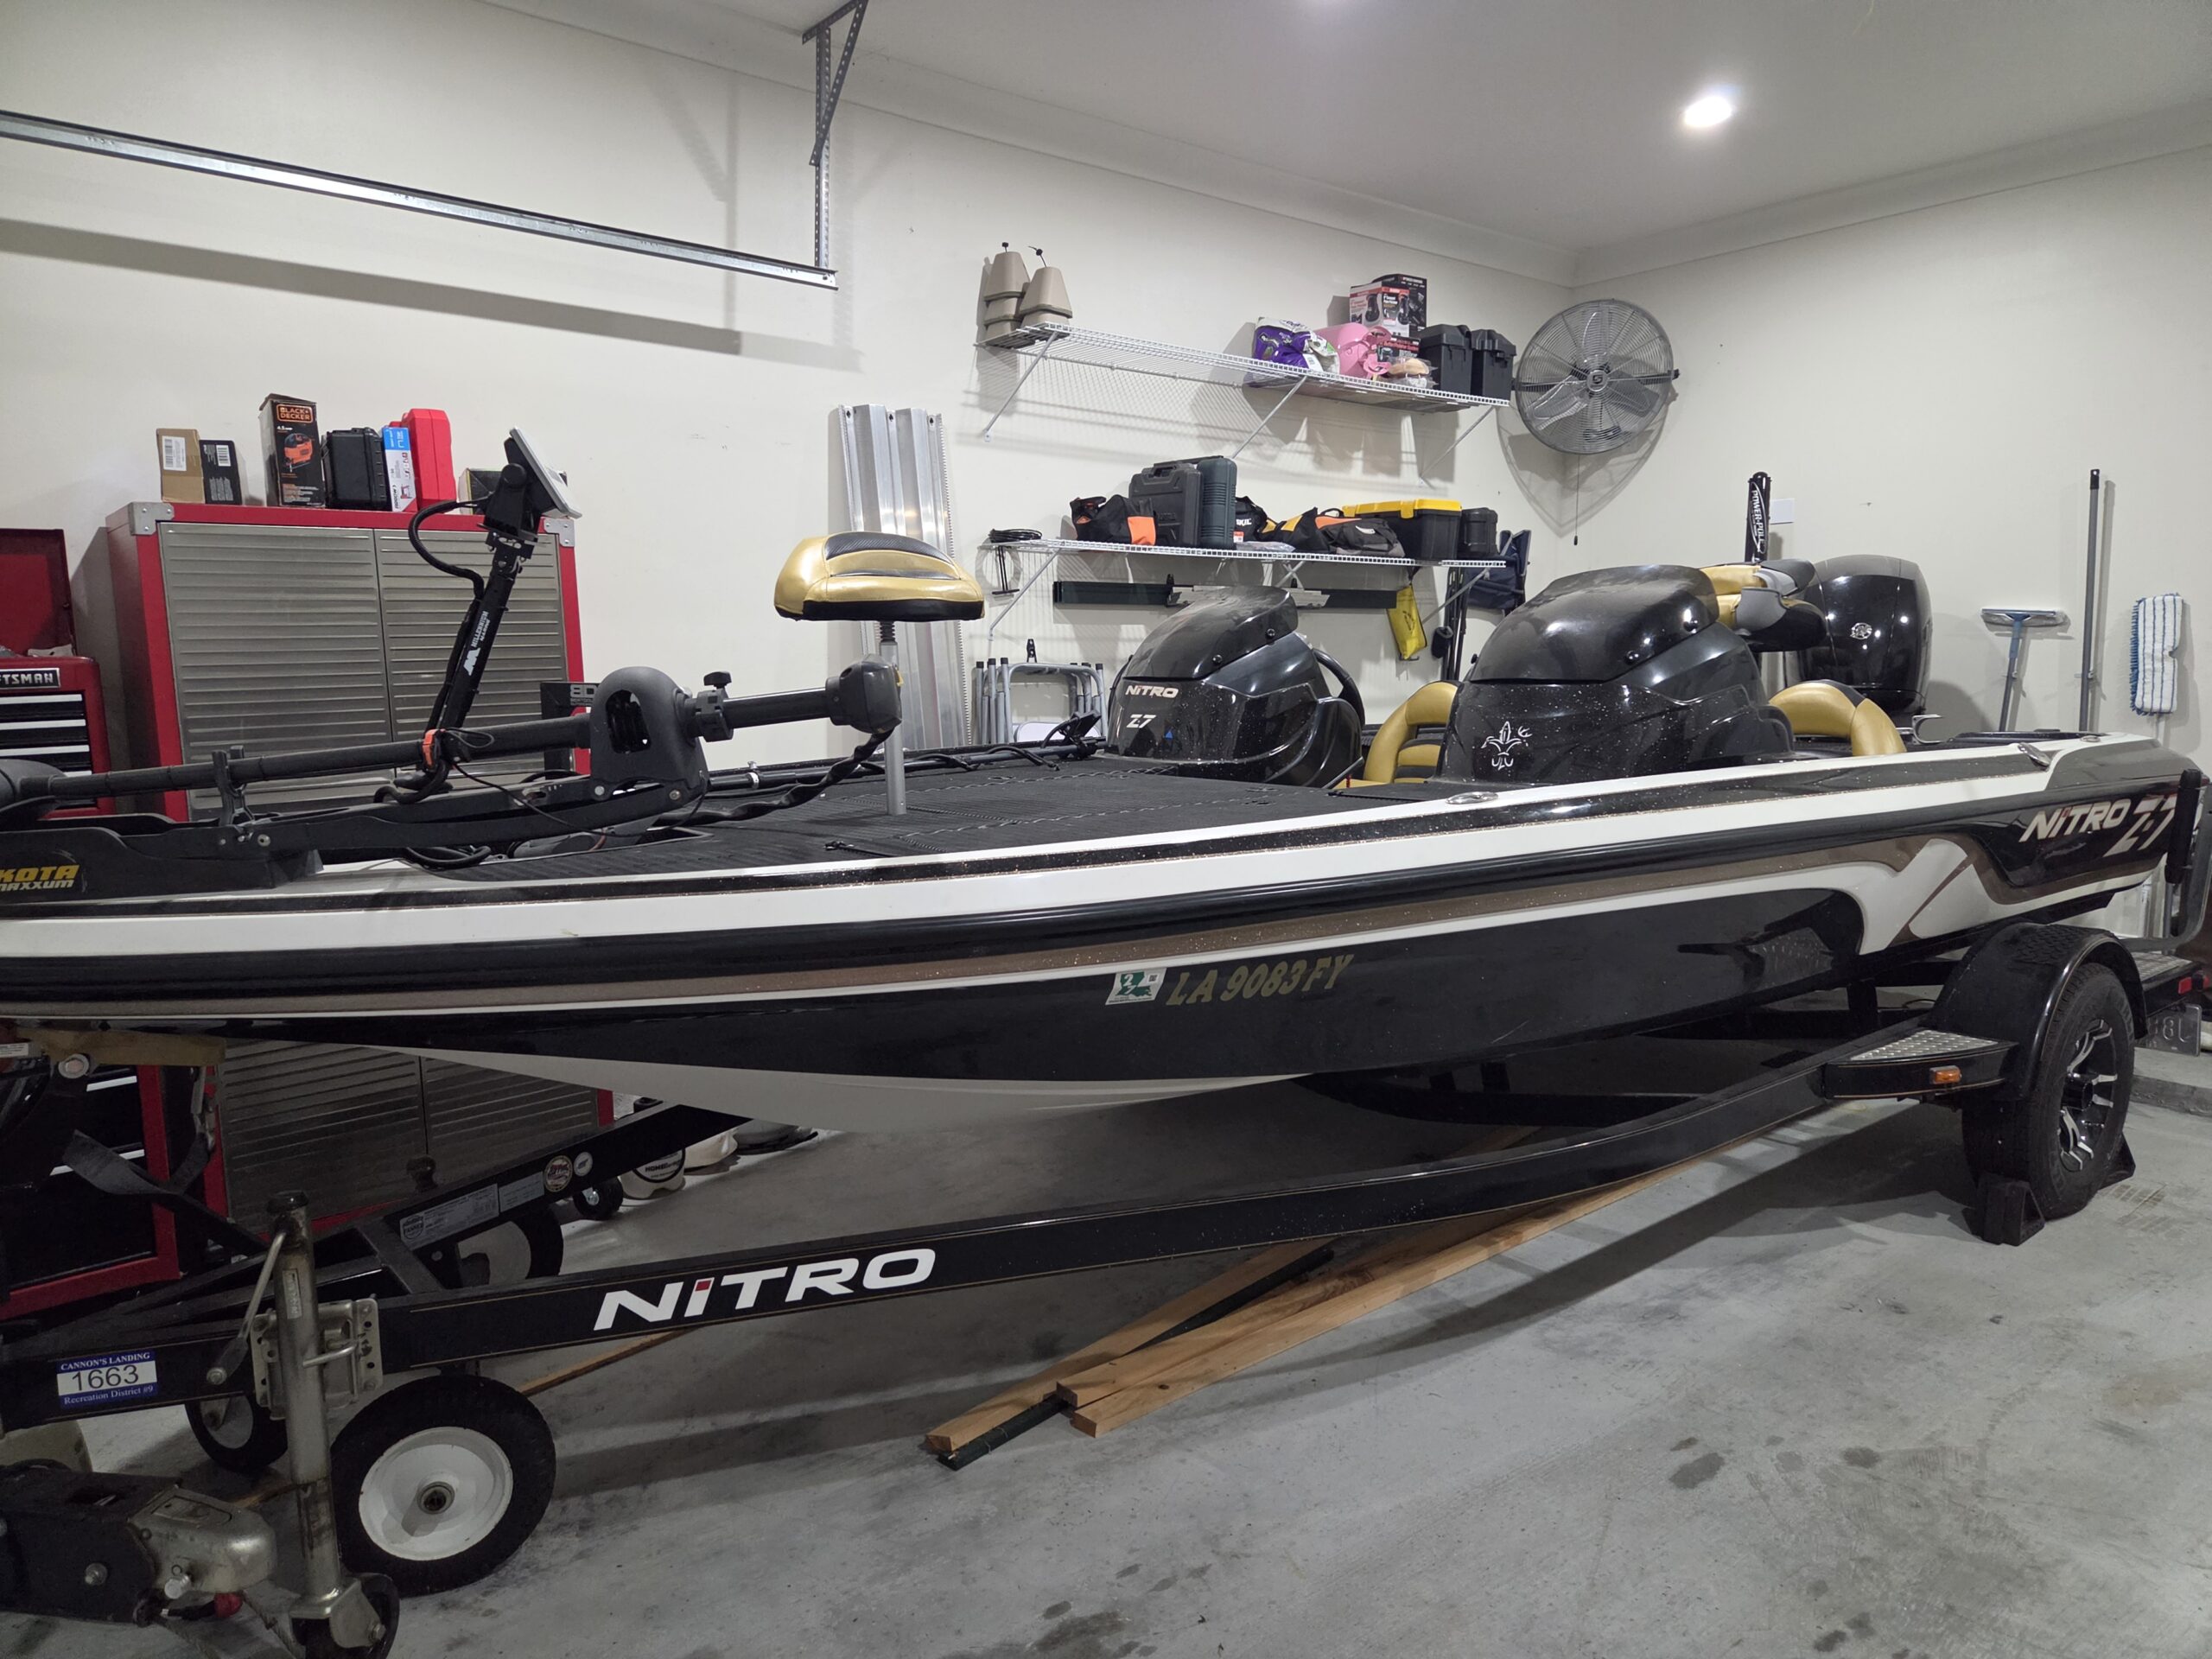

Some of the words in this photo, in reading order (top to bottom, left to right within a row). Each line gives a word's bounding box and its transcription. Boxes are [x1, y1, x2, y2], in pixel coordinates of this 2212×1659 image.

[0, 672, 54, 684] TSMAN
[60, 1357, 108, 1370] CANNON'S
[109, 1352, 150, 1364] LANDING
[72, 1364, 139, 1391] 1663
[64, 1391, 109, 1405] Recreation
[111, 1387, 142, 1398] District
[143, 1385, 154, 1394] #9
